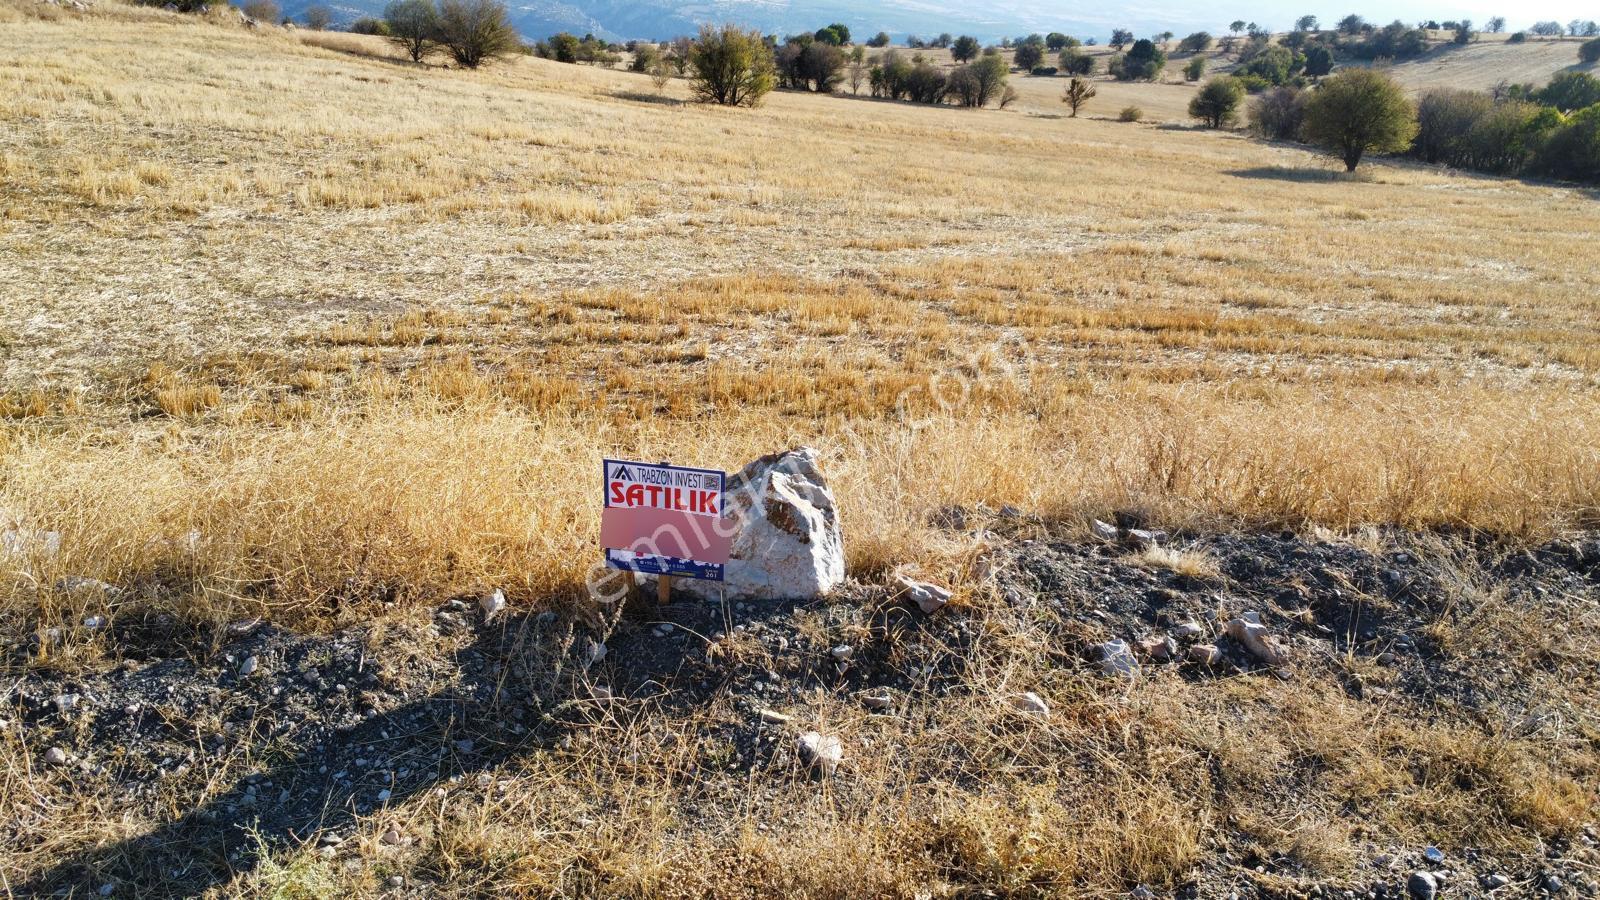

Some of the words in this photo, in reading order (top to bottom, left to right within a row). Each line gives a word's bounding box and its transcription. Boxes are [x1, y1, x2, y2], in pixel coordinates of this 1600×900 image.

[637, 467, 673, 486] TRABZON
[675, 471, 703, 488] INVEST
[610, 481, 718, 514] SATILIK
